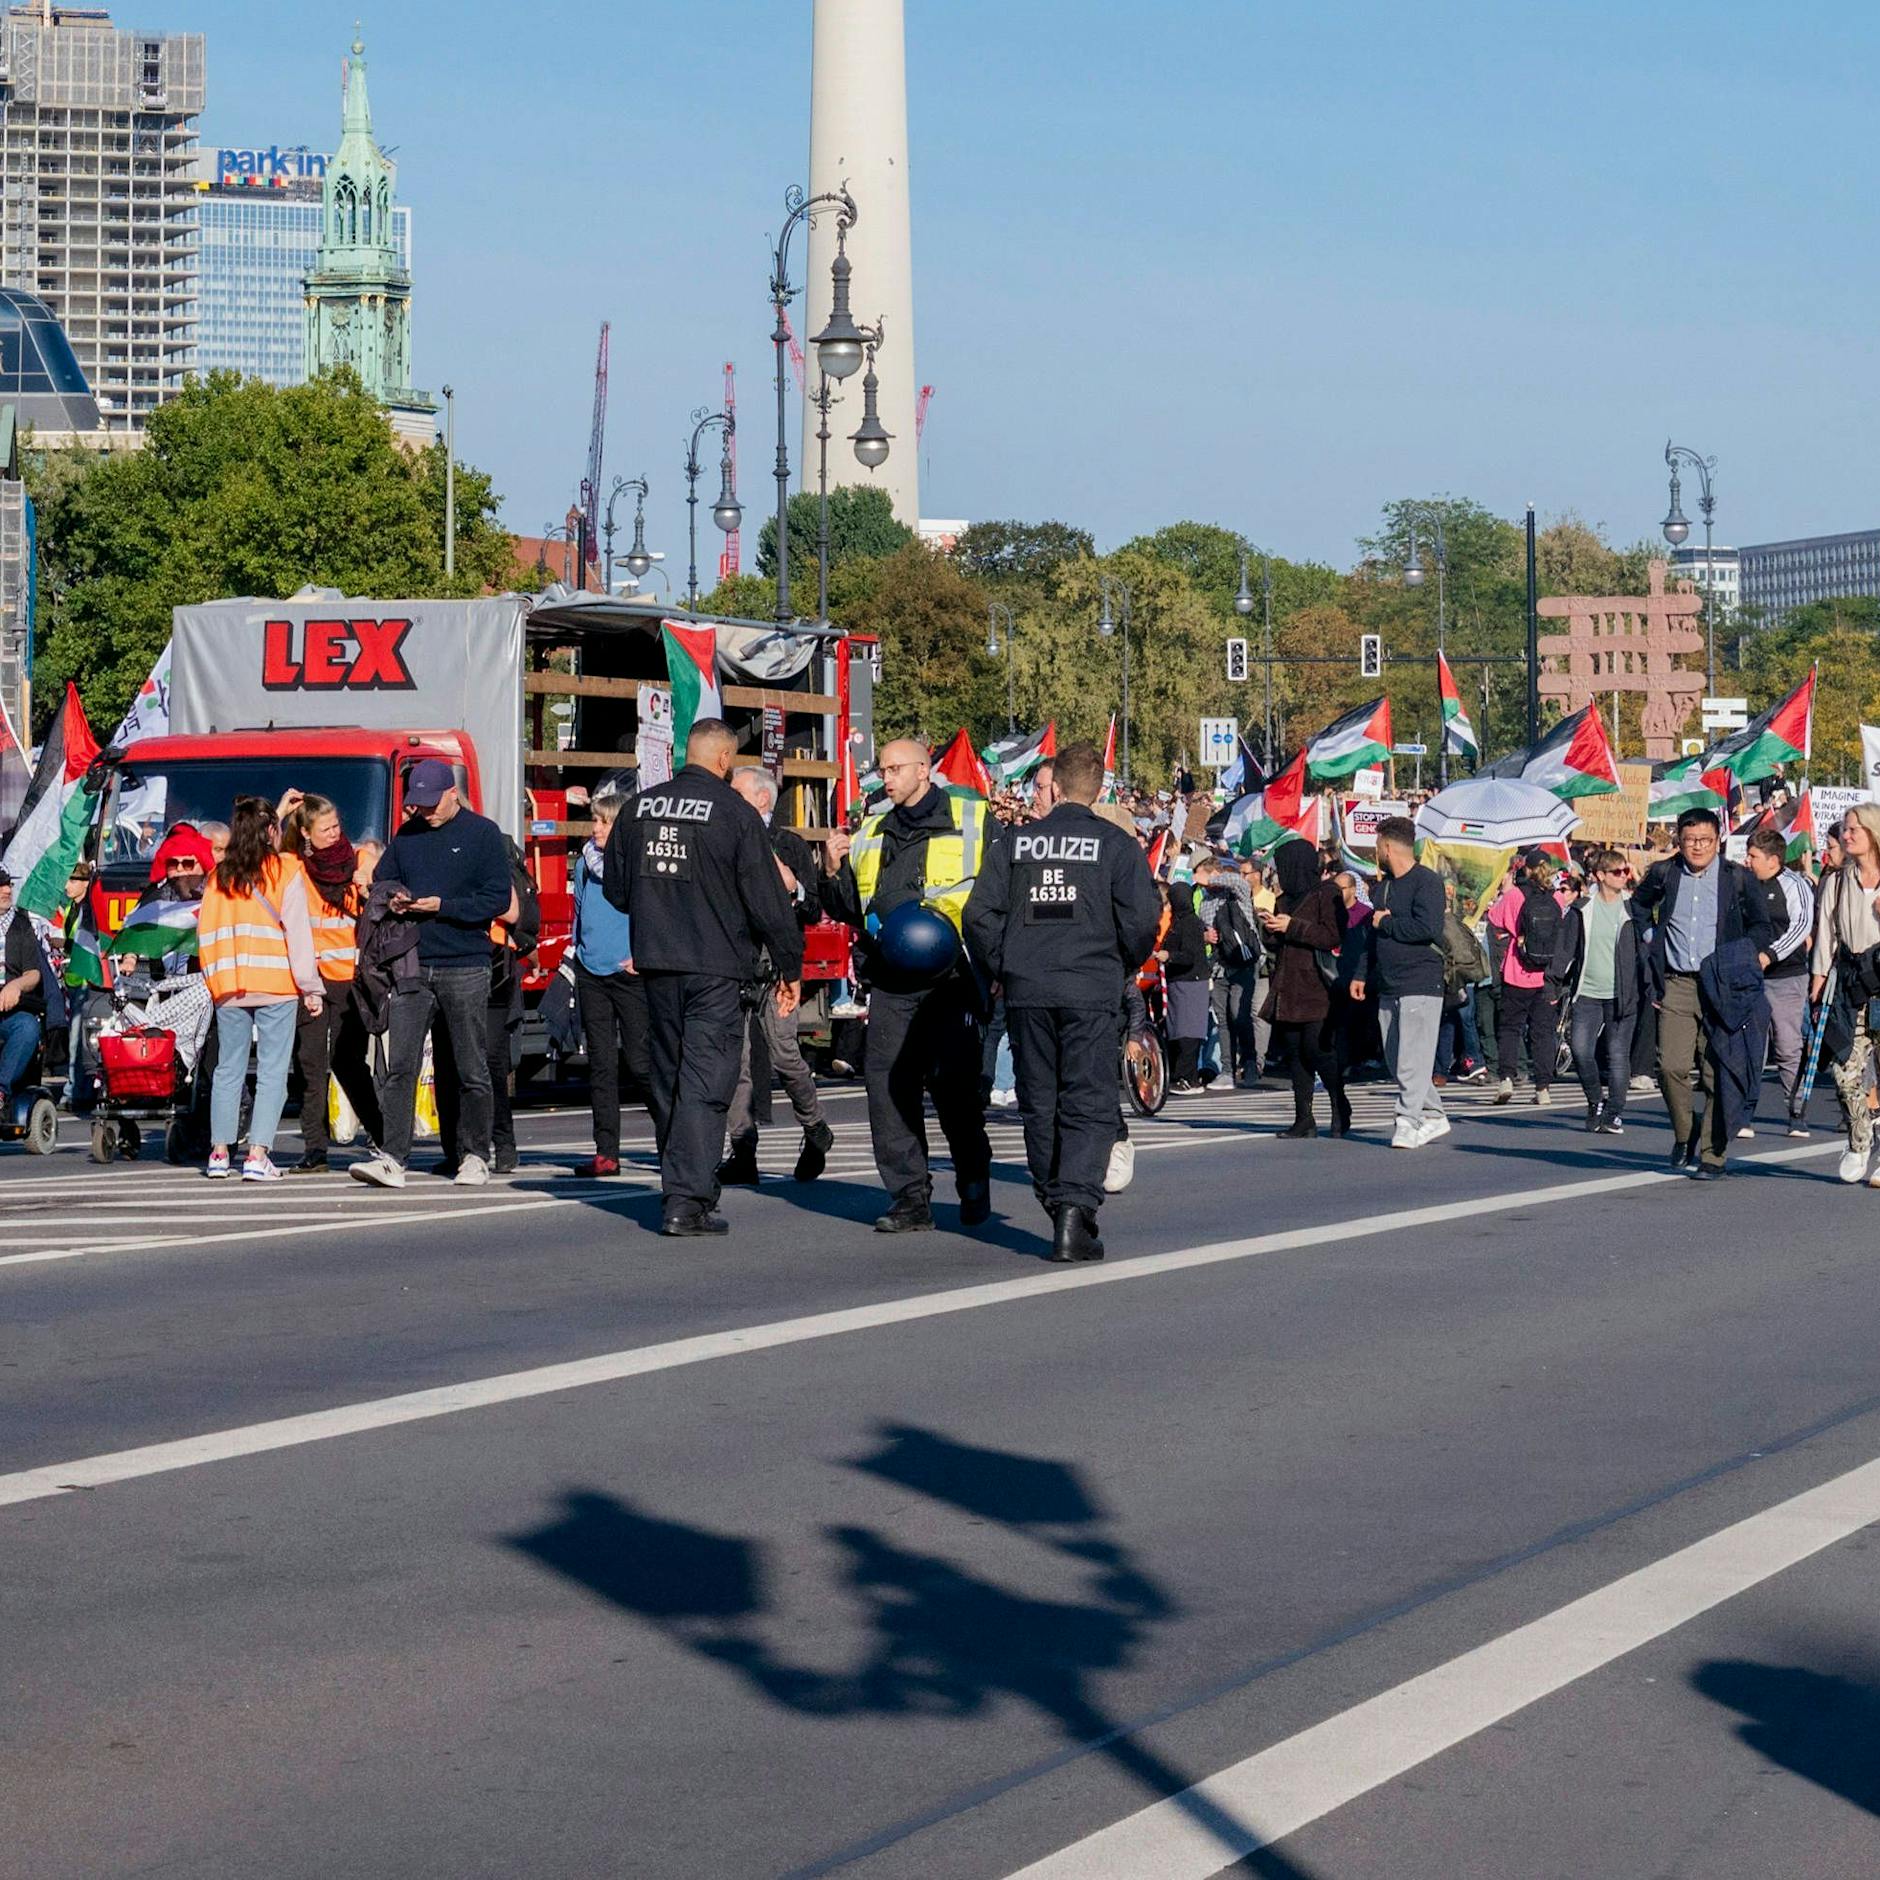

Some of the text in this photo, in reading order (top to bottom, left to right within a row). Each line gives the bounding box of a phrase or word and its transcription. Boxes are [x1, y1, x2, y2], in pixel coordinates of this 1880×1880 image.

[217, 145, 333, 184] park in
[262, 619, 418, 691] LEX
[1820, 789, 1861, 801] IMAGINE
[636, 796, 714, 821] POLIZEI
[1354, 813, 1375, 822] STOP
[659, 826, 679, 842] BE
[1585, 823, 1596, 836] to
[1601, 822, 1616, 837] the
[646, 841, 688, 859] 16311
[1014, 835, 1101, 861] POLIZEI
[1042, 868, 1064, 885] BE
[1029, 886, 1077, 902] 16318
